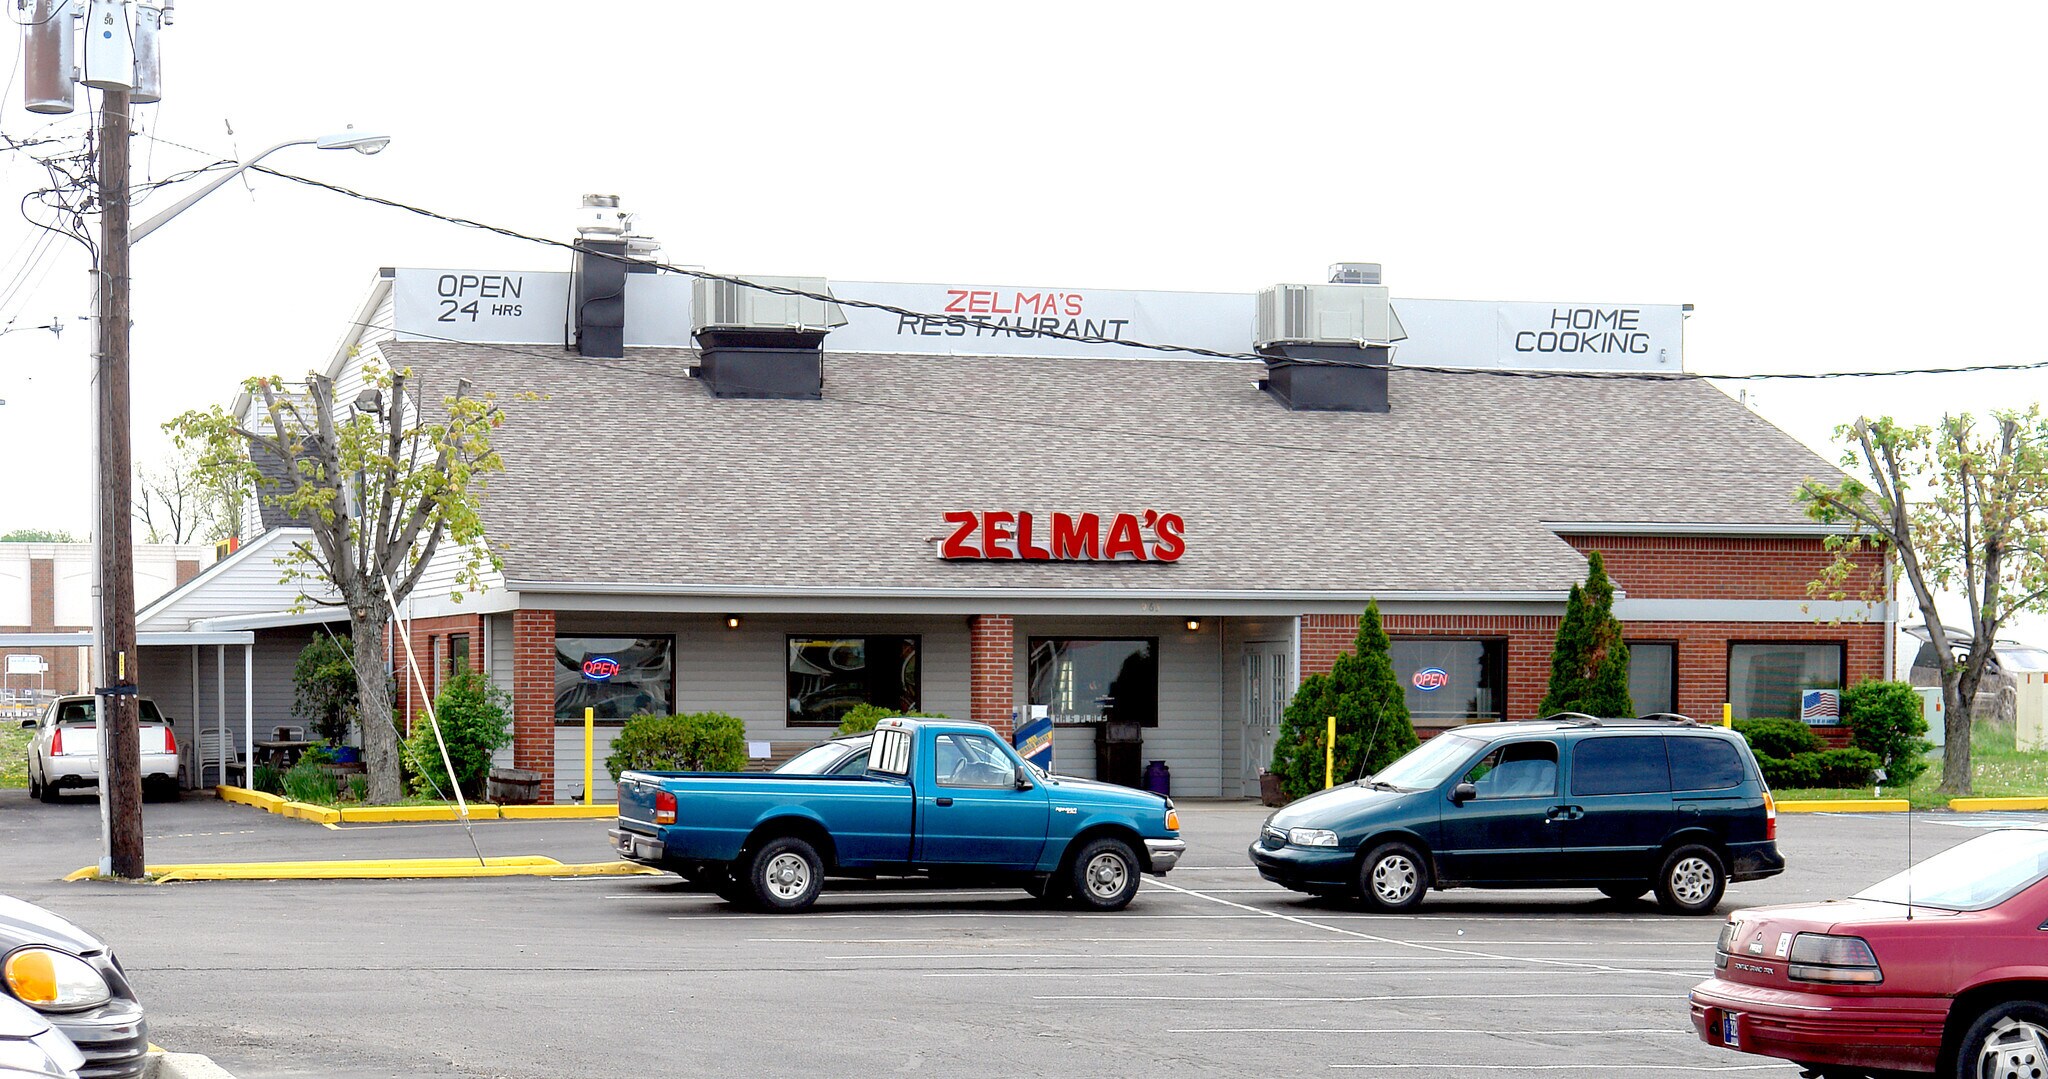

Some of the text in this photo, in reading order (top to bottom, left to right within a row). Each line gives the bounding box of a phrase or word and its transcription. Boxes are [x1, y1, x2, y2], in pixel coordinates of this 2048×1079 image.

[104, 16, 114, 26] 50
[437, 274, 523, 299] OPEN
[437, 299, 523, 322] 24 HRS
[944, 289, 1084, 316] ZELMA'S
[896, 313, 1129, 341] RESTAURANT
[1550, 308, 1640, 330] HOME
[1514, 331, 1650, 354] COOKING
[941, 508, 1187, 562] ZELMA'S
[583, 660, 621, 677] OPEN
[1412, 670, 1449, 687] OPEN
